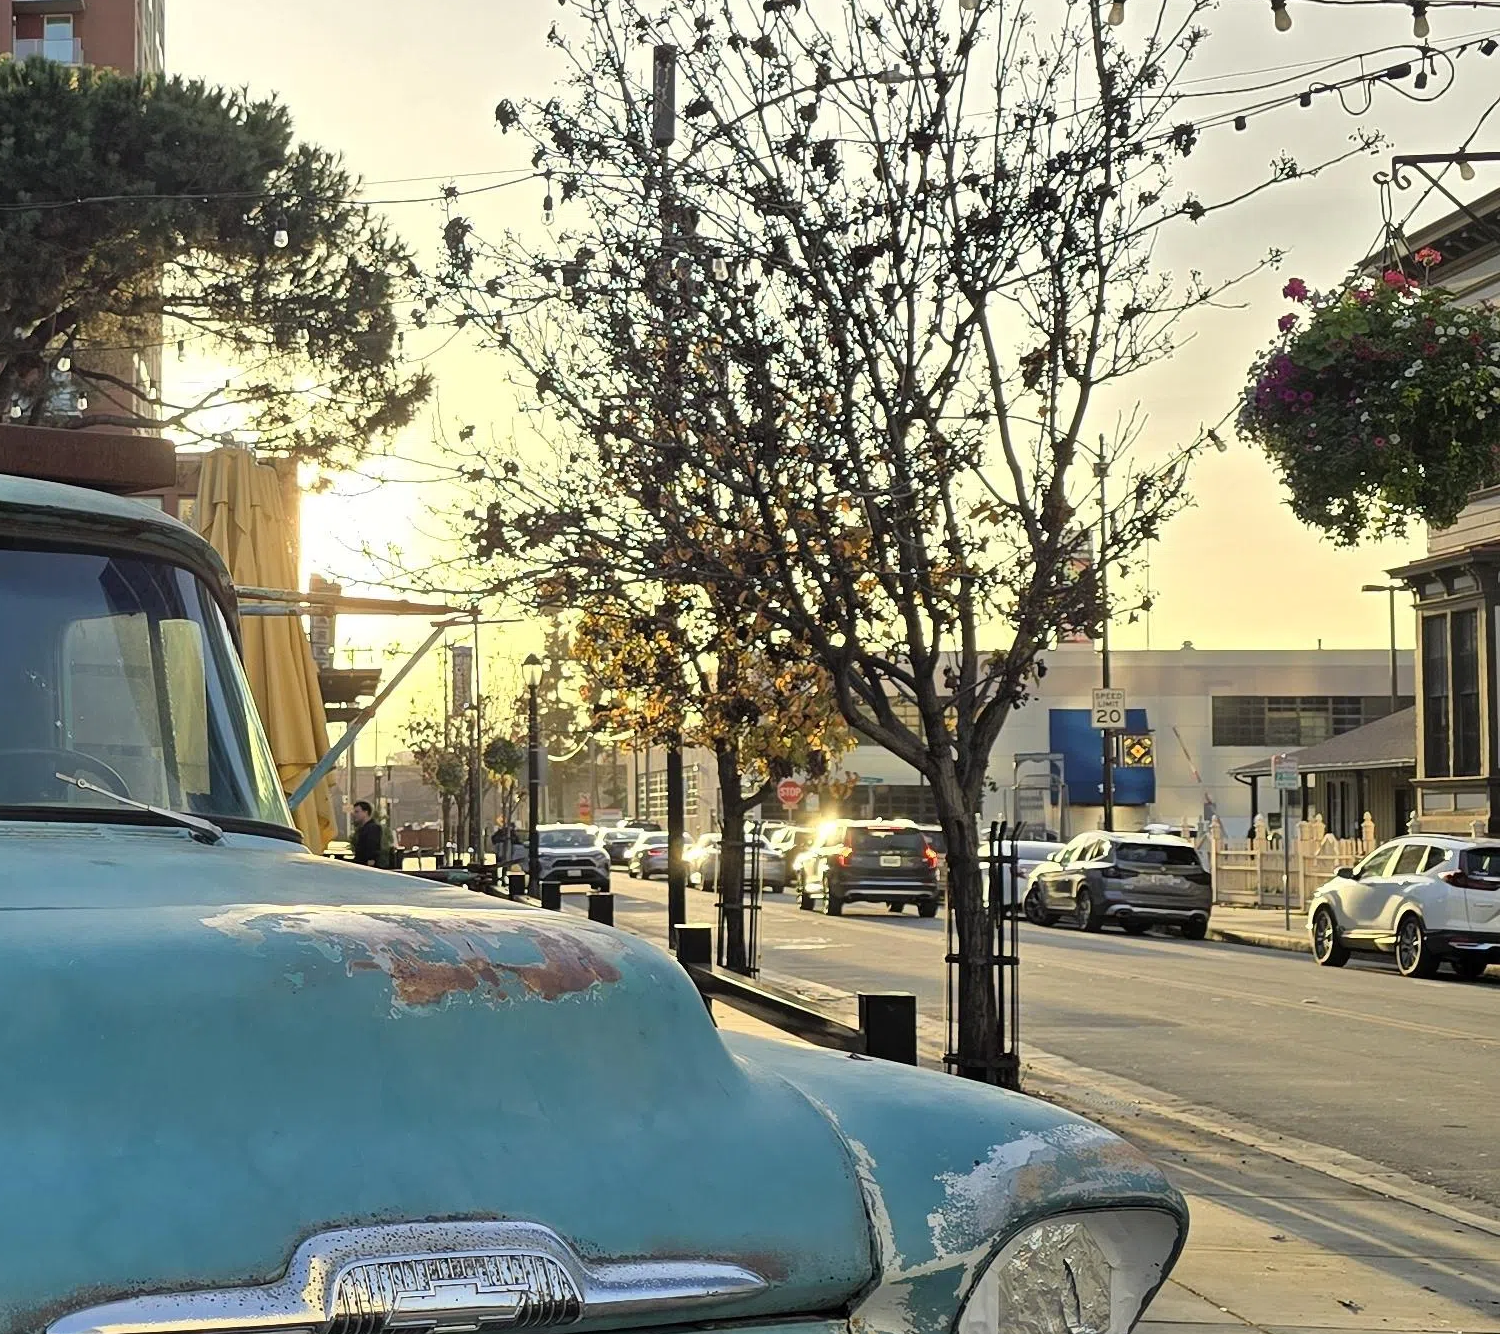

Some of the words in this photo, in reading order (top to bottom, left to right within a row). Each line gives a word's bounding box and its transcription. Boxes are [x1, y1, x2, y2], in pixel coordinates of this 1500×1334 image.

[1095, 692, 1123, 700] SPEED
[1098, 700, 1119, 708] LIMIT
[1096, 709, 1122, 724] 20
[780, 787, 802, 798] STOP
